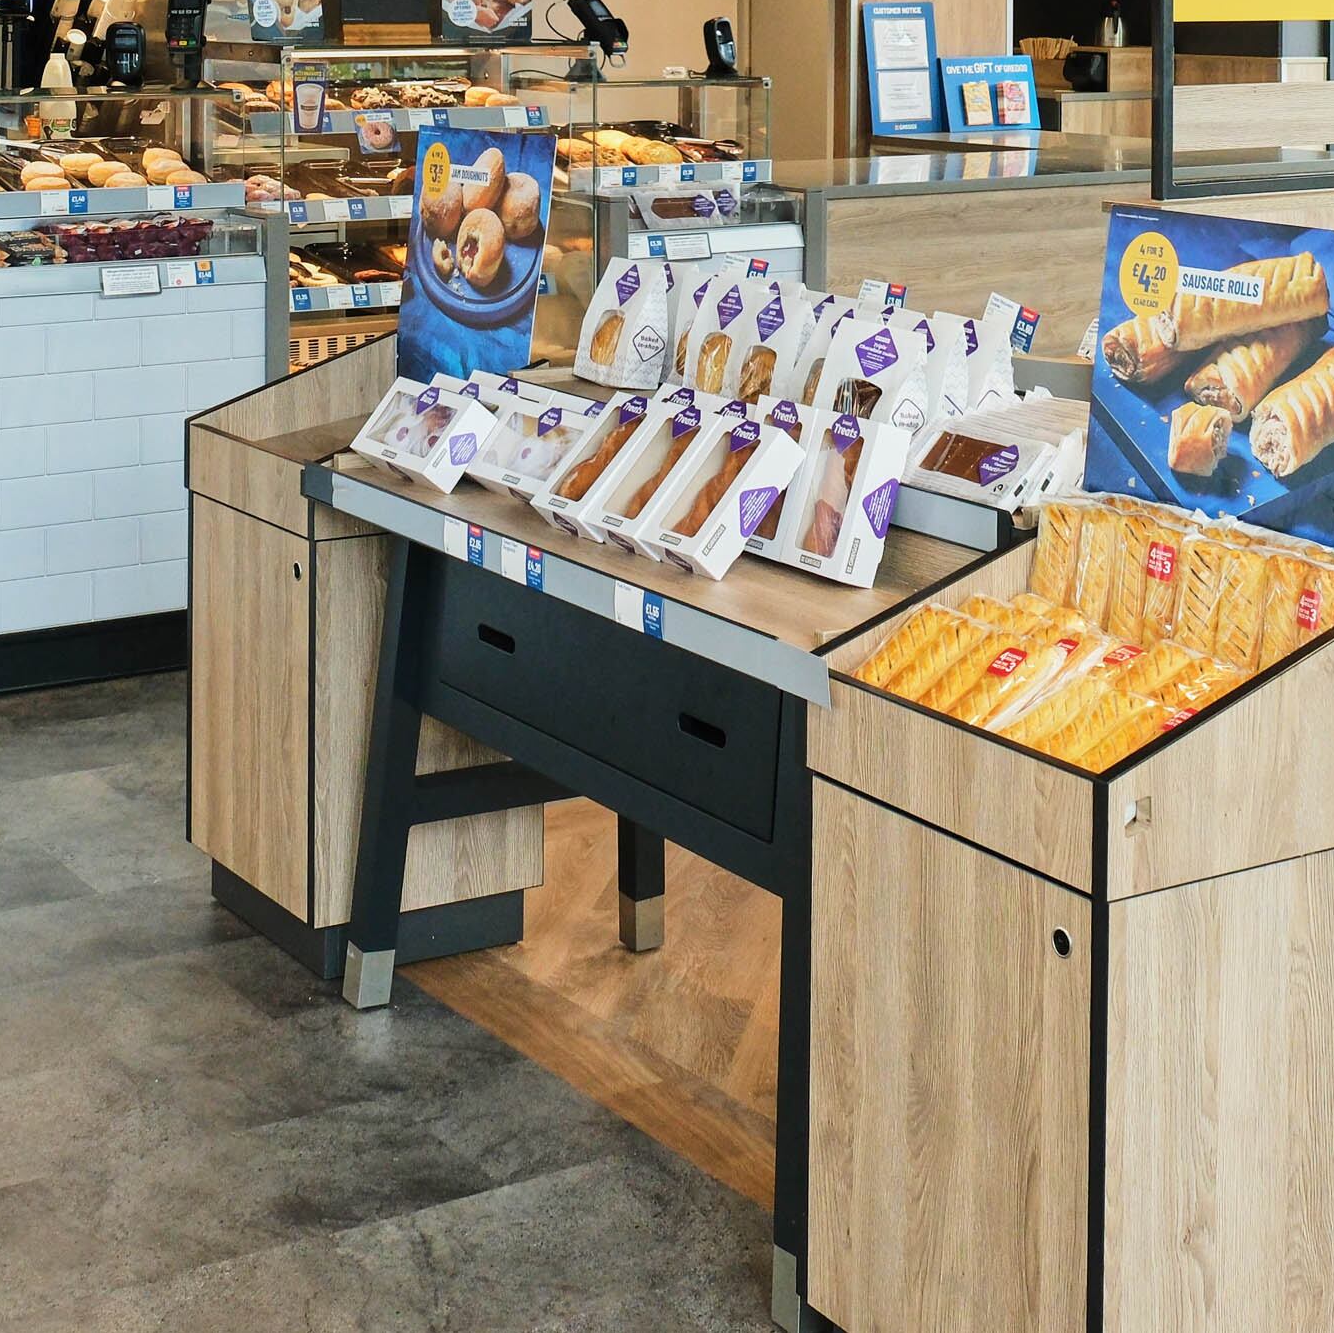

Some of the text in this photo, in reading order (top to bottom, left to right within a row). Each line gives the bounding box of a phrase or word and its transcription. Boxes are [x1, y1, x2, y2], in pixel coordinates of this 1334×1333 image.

[946, 66, 961, 75] GIVE
[961, 65, 973, 74] THE
[973, 62, 993, 73] GIFT
[995, 65, 1003, 73] OF
[452, 168, 488, 182] JAM DOUGHNUTS
[1139, 244, 1164, 258] 4 FOR 3
[1132, 263, 1166, 293] £4.20
[1182, 273, 1259, 298] SAUSAGE ROLLS
[622, 402, 643, 415] Treats
[674, 414, 698, 427] Treats
[773, 410, 797, 424] Treats
[732, 427, 757, 441] Treats
[833, 425, 858, 439] Treats
